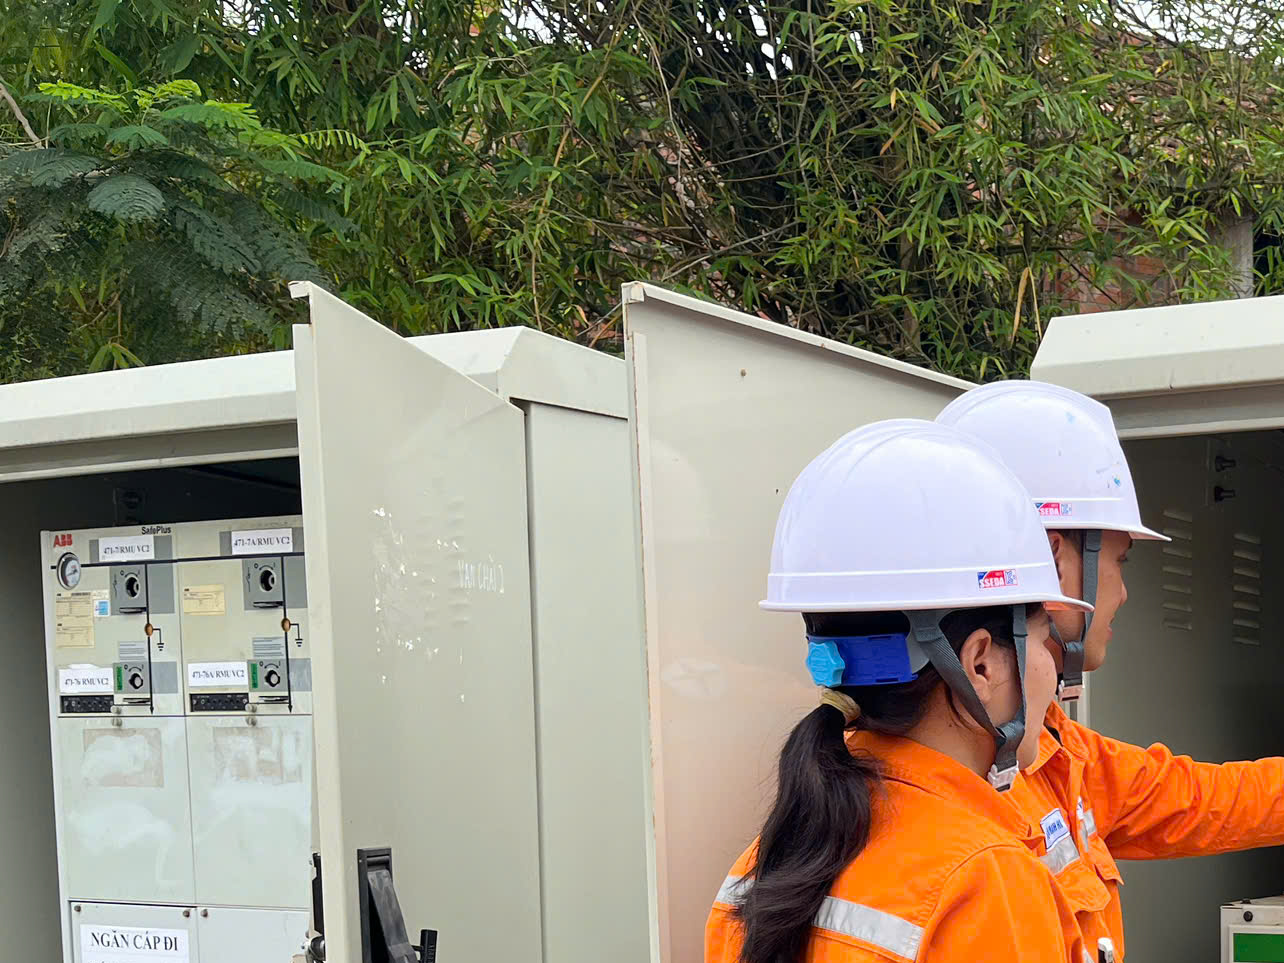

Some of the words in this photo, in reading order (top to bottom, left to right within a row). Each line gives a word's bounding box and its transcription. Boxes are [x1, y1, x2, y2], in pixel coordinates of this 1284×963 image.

[141, 526, 172, 535] SafePlus
[53, 534, 73, 548] ABB
[133, 931, 161, 950] CÁP
[164, 936, 178, 951] ĐI
